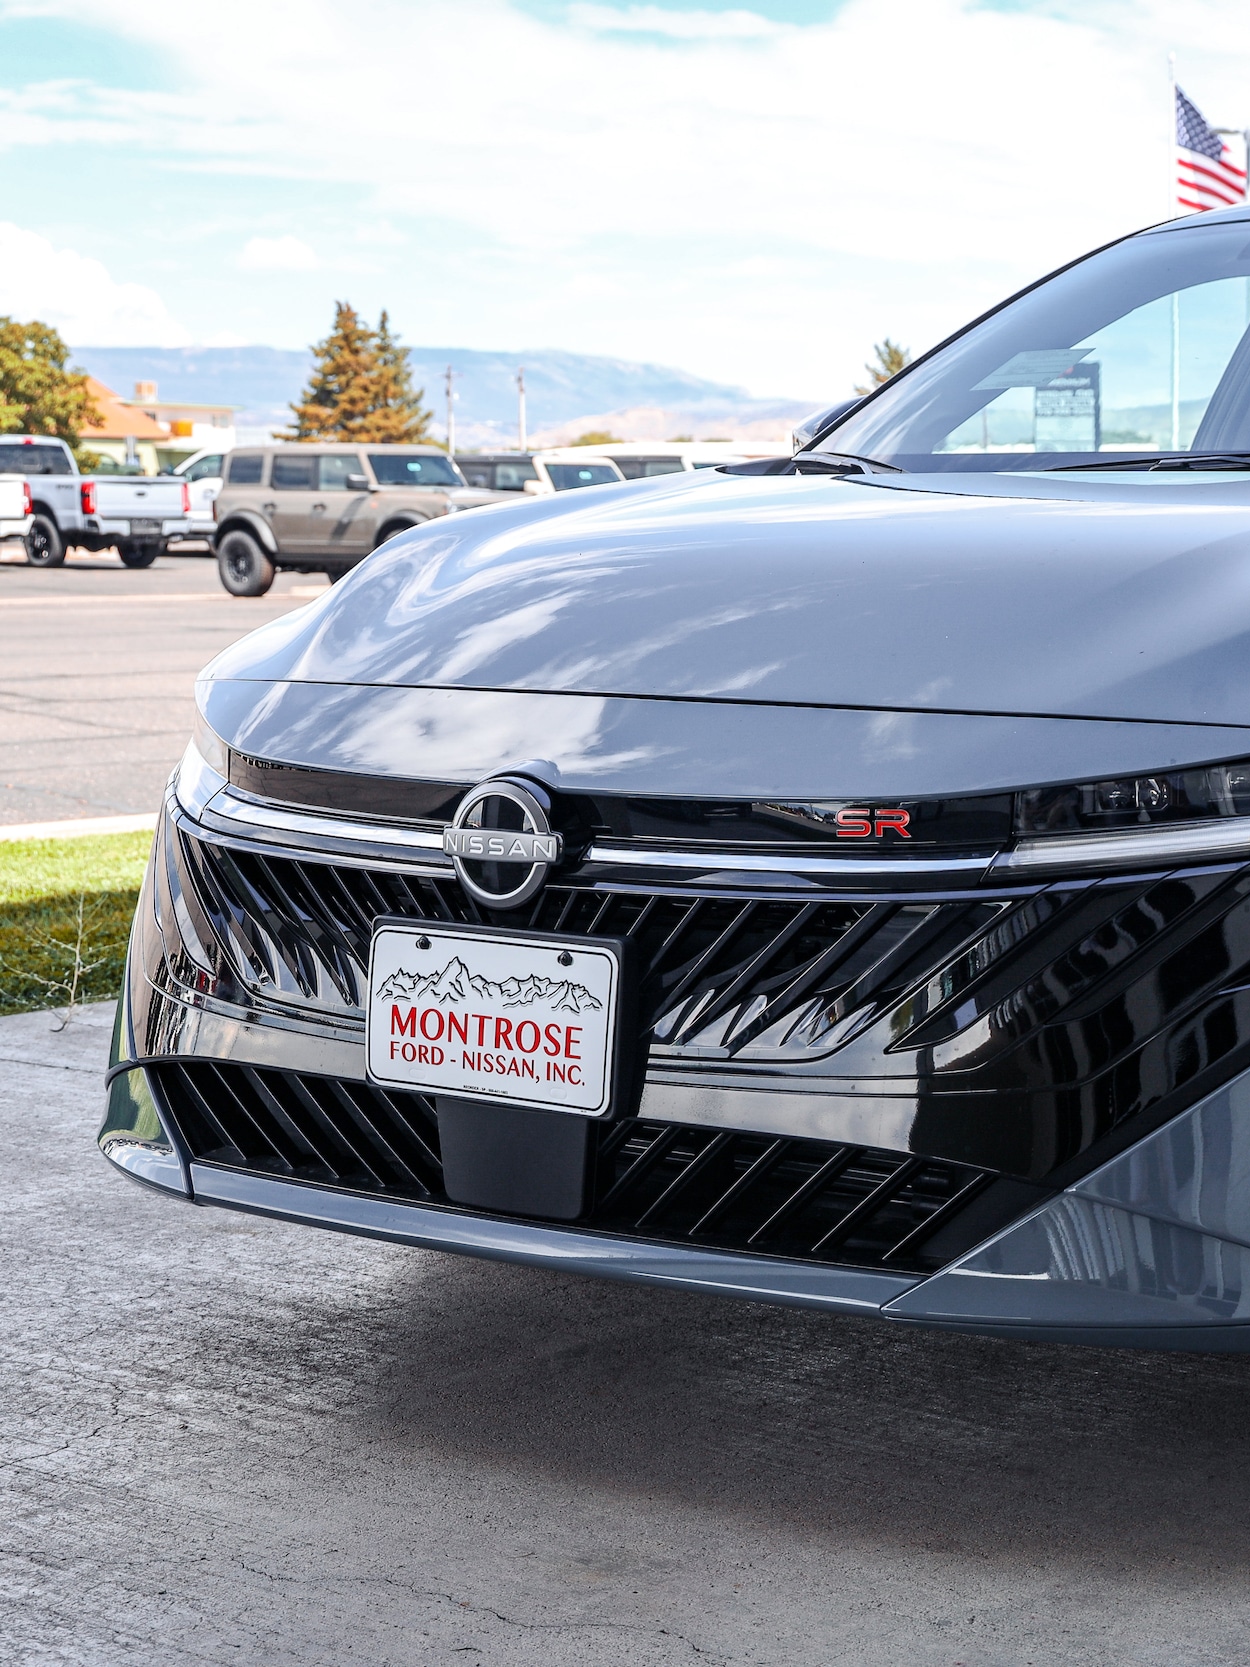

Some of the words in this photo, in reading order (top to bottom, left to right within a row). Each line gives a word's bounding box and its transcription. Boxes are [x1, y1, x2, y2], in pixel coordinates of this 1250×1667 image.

[836, 808, 912, 838] SR
[445, 833, 553, 858] NISSAN
[390, 1004, 583, 1060] MONTROSE
[390, 1041, 444, 1066] FORD
[462, 1050, 541, 1083] NISSAN,
[546, 1062, 586, 1086] INC.
